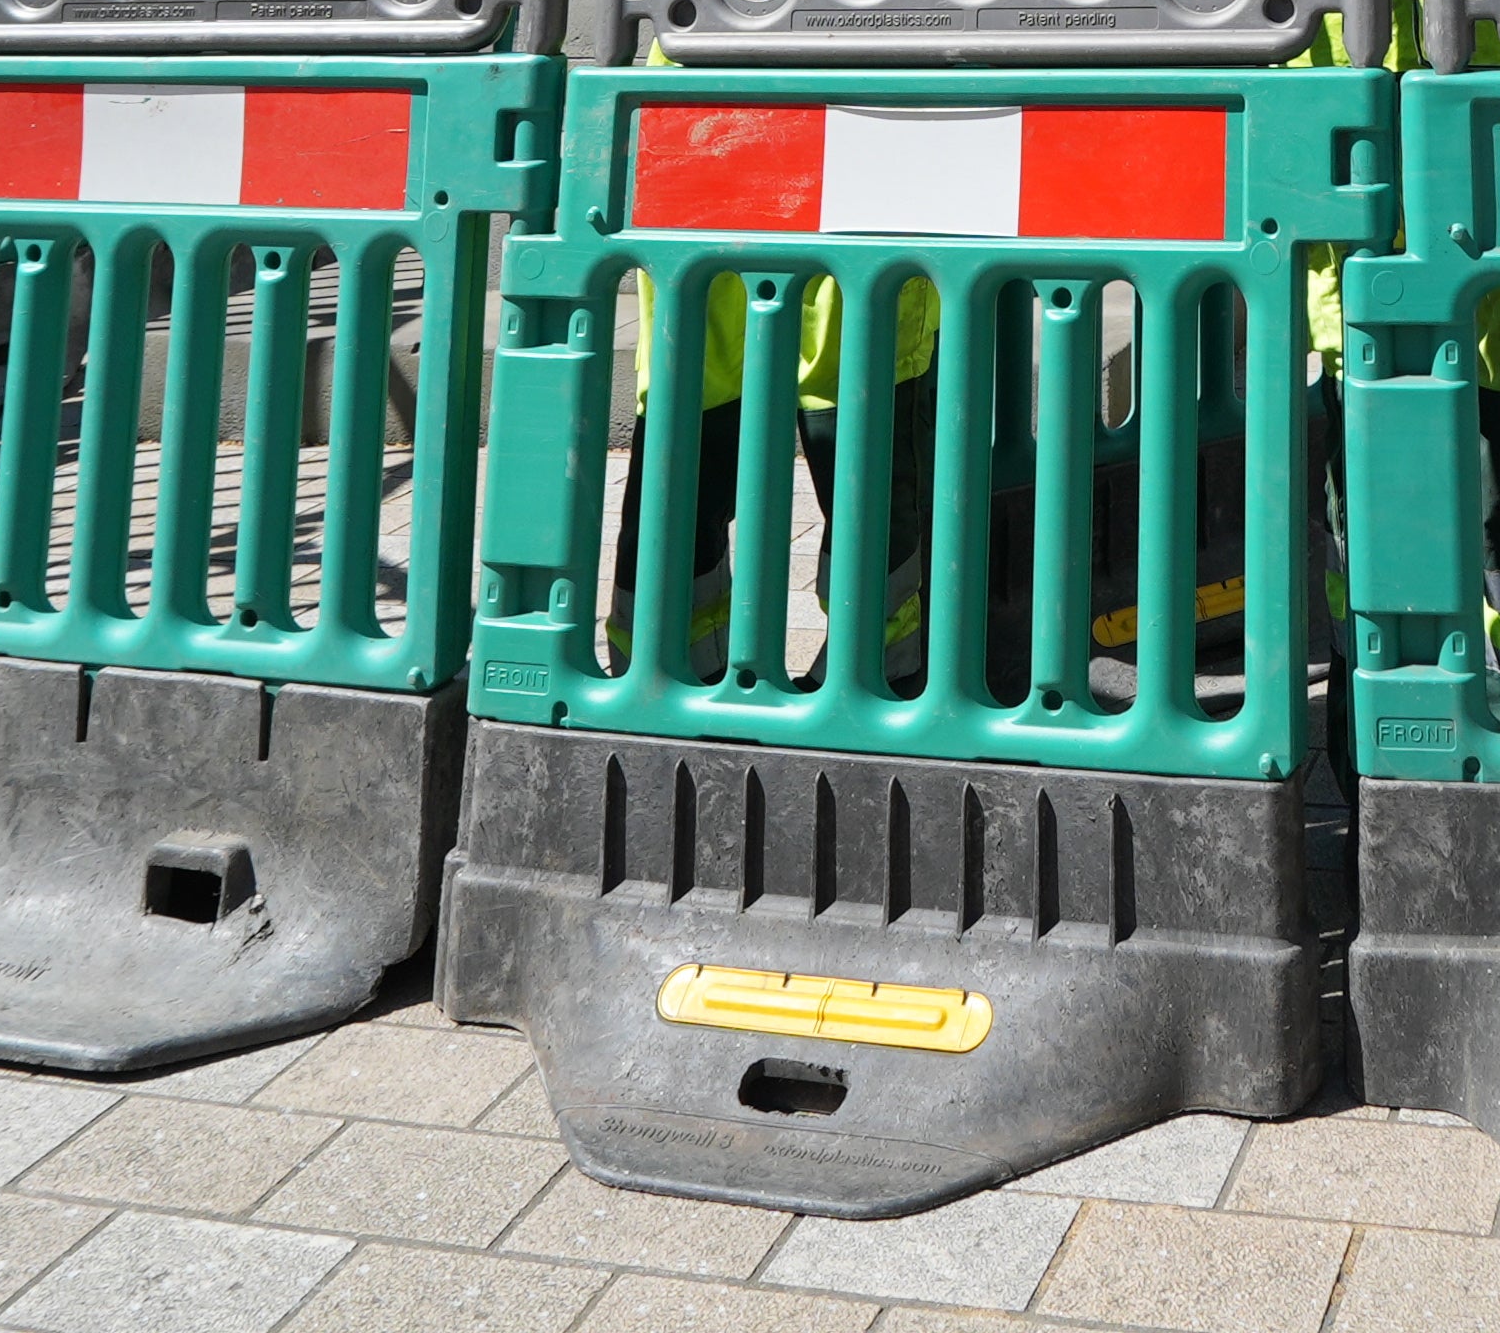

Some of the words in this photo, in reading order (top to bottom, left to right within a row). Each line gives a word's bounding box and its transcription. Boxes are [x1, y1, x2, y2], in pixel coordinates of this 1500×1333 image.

[250, 2, 287, 17] Patent
[289, 2, 333, 20] pending
[804, 11, 952, 28] www.oxfordplastics.com
[1018, 11, 1060, 26] Patent
[1064, 11, 1116, 28] pending
[487, 666, 549, 687] FRONT
[1380, 724, 1454, 744] FRONT
[598, 1116, 714, 1148] Strongwall
